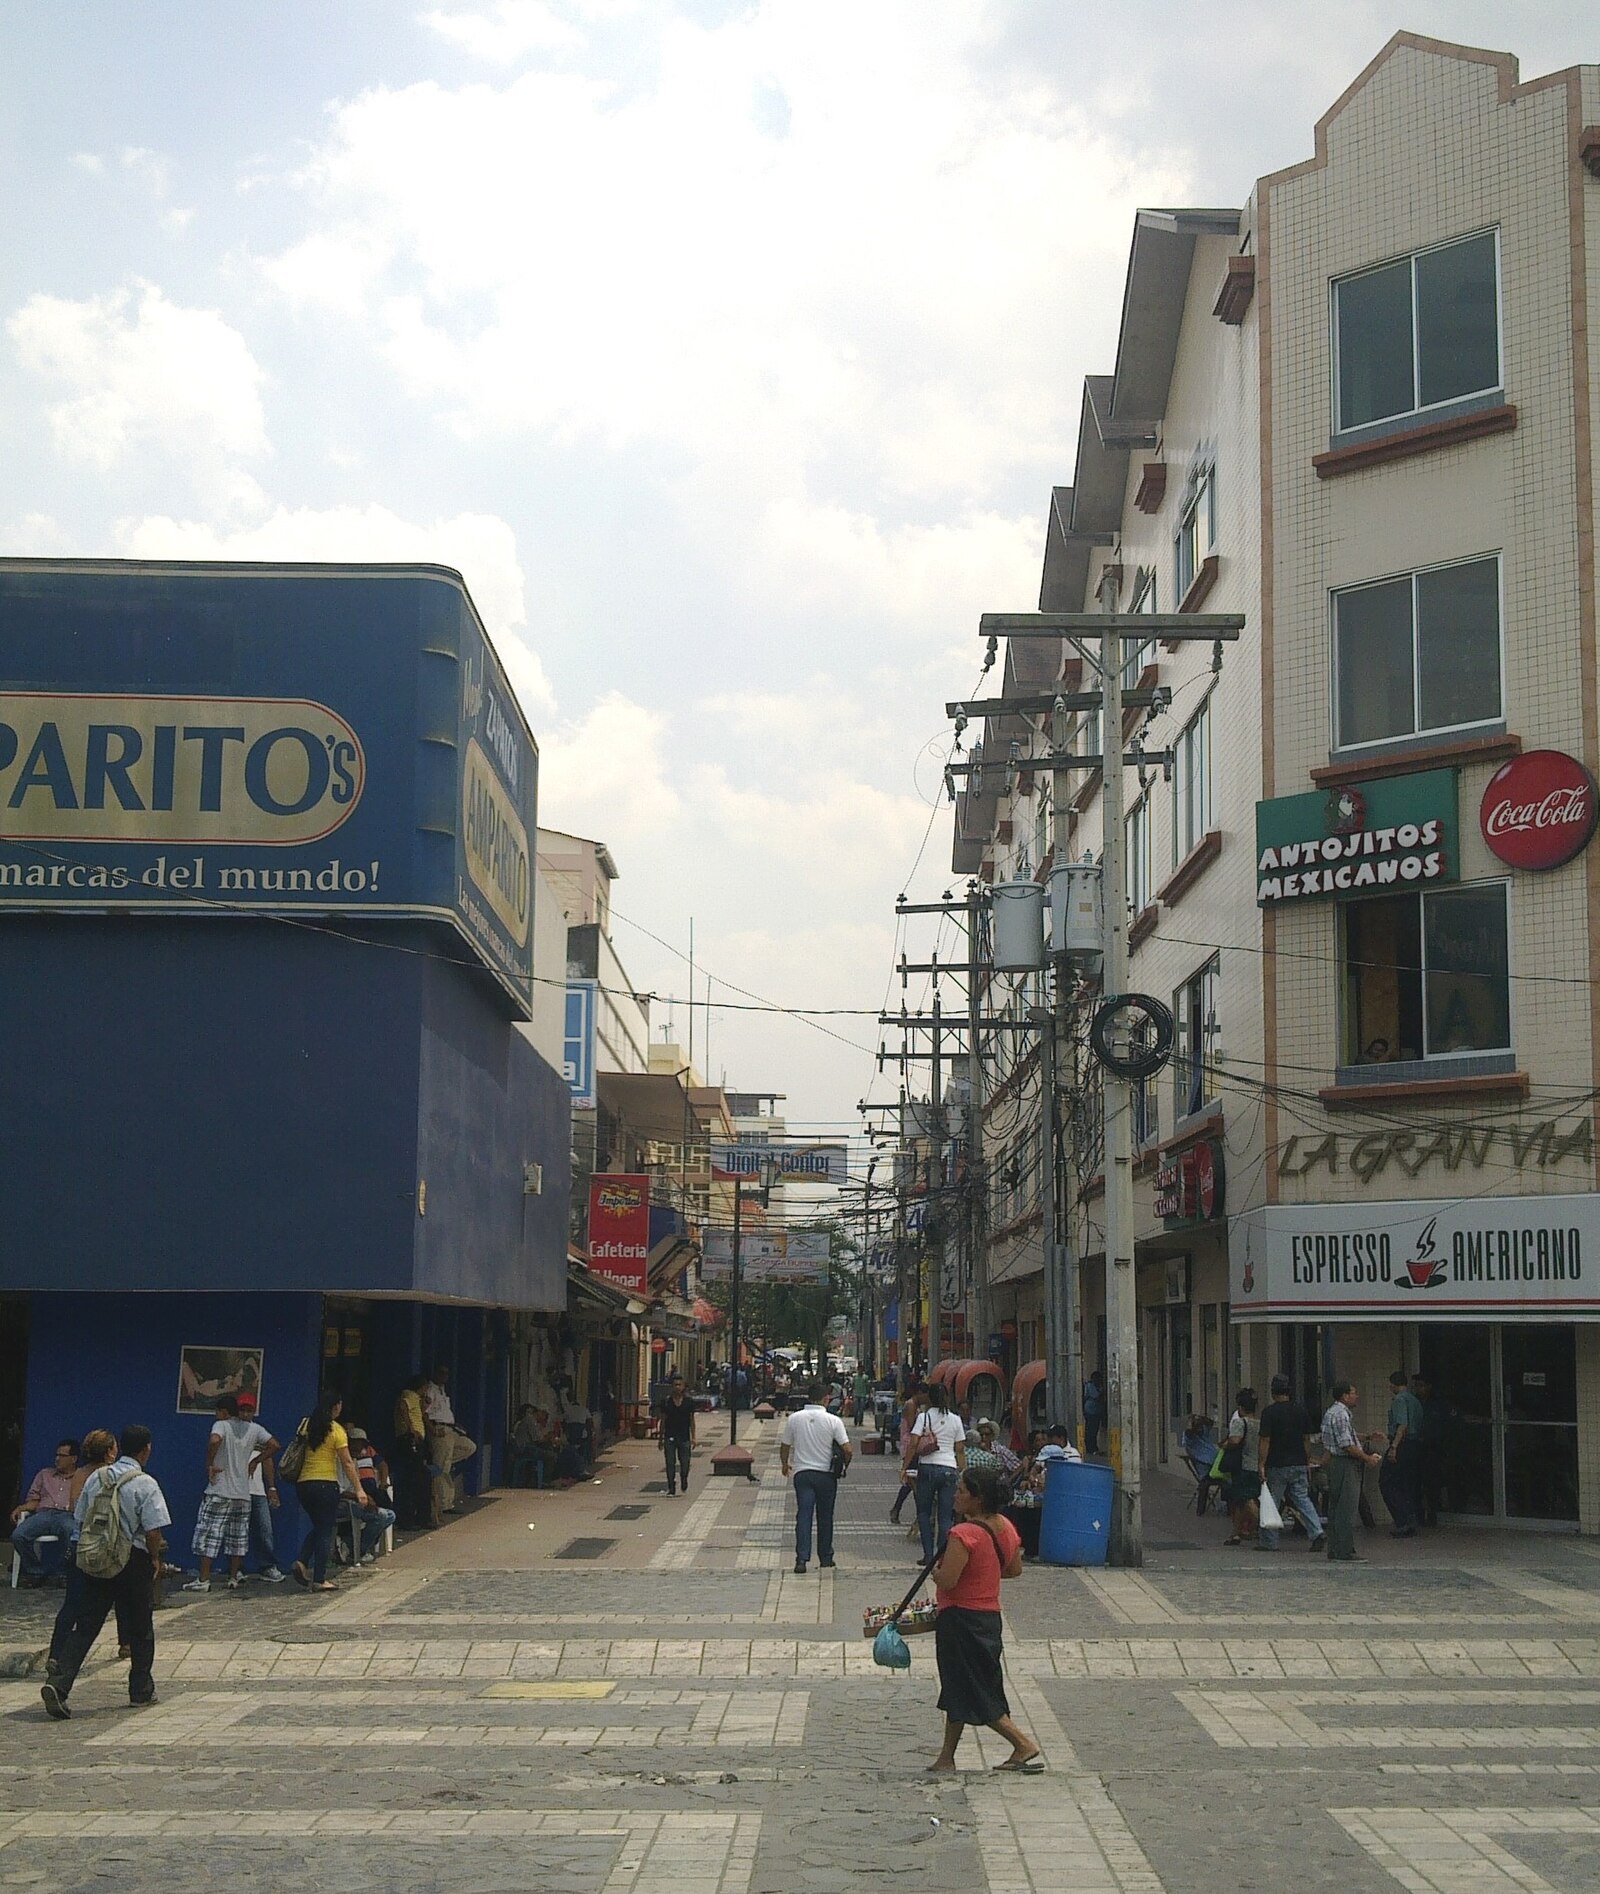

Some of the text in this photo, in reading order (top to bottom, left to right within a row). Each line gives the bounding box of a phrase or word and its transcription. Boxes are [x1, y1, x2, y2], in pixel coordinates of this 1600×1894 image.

[1486, 784, 1590, 836] Coca-Cola
[1257, 819, 1438, 871] ANTOJITOS
[142, 856, 205, 889] del
[218, 859, 380, 892] mundo!
[1257, 852, 1441, 900] MEXICANOS
[780, 1151, 829, 1173] Center
[1277, 1115, 1594, 1185] LA GRAN VIA
[589, 1241, 647, 1258] Cafeteria
[1291, 1228, 1582, 1284] ESPRESSO AMERICANO
